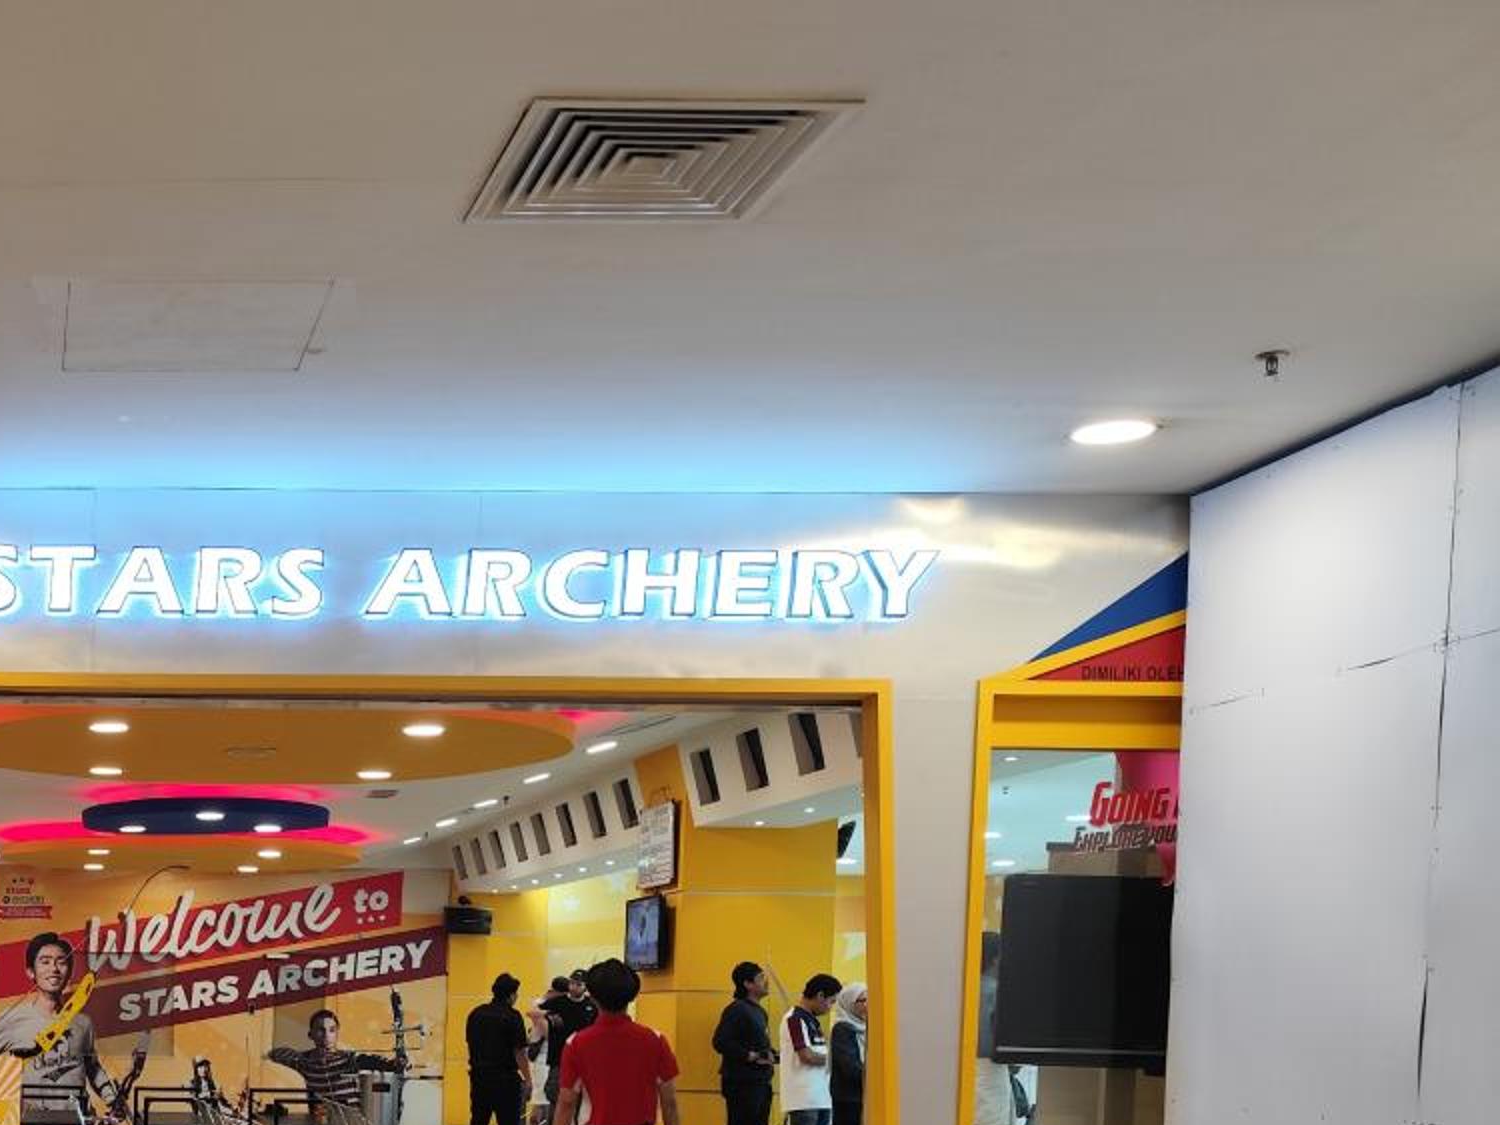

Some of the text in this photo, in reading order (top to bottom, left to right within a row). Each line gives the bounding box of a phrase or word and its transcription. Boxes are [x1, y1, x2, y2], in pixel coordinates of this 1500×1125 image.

[364, 547, 941, 619] ARCHERY
[1081, 664, 1141, 681] DIMILIKI
[1090, 781, 1171, 827] GOING
[1148, 824, 1178, 846] YOU
[85, 888, 390, 972] Welcome to
[118, 938, 433, 1022] STARS ARCHERY
